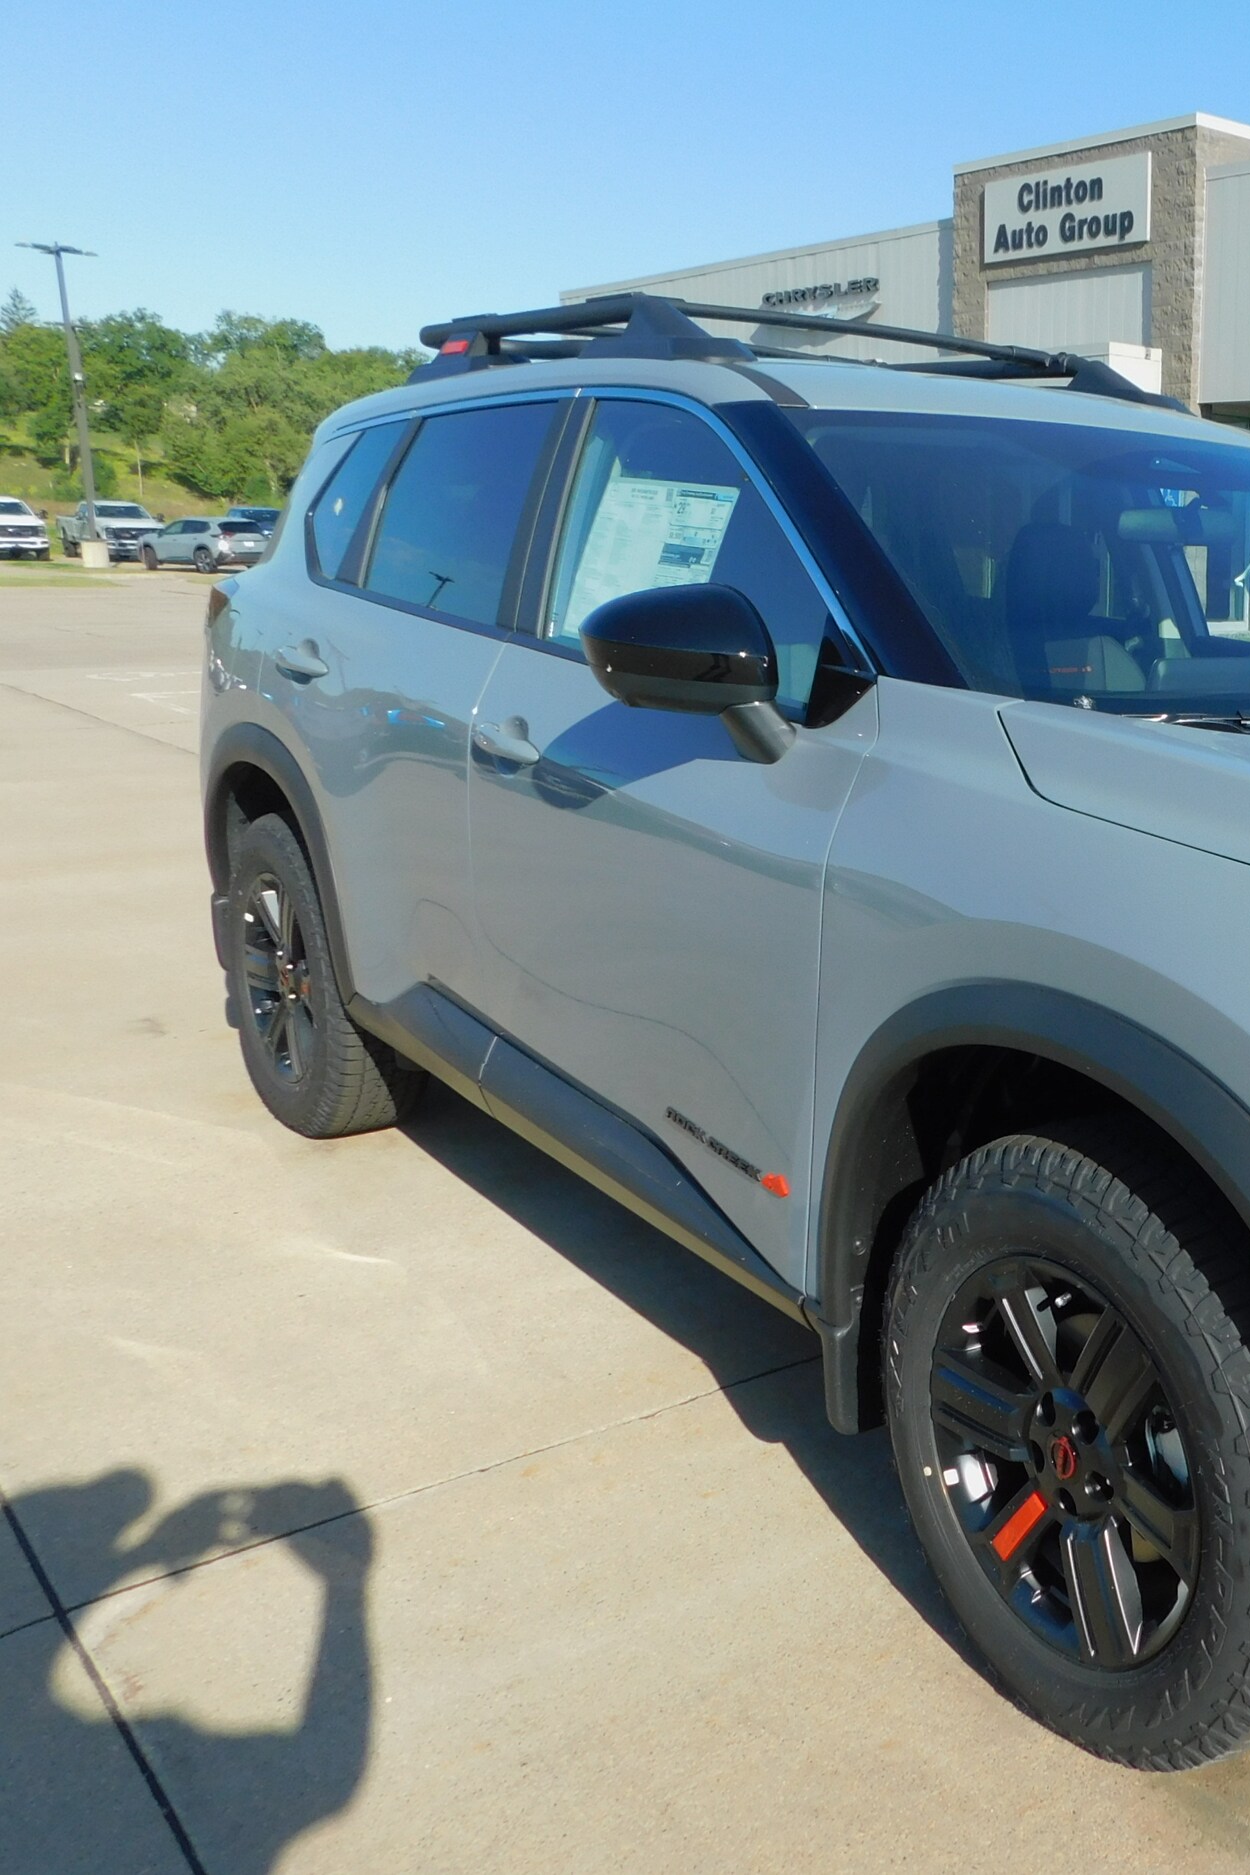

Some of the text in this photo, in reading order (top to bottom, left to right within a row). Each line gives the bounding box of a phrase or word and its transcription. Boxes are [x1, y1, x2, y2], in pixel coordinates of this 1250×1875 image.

[1018, 176, 1103, 213] Clinton
[993, 210, 1134, 254] Auto Group
[763, 277, 879, 306] CHRYSLER
